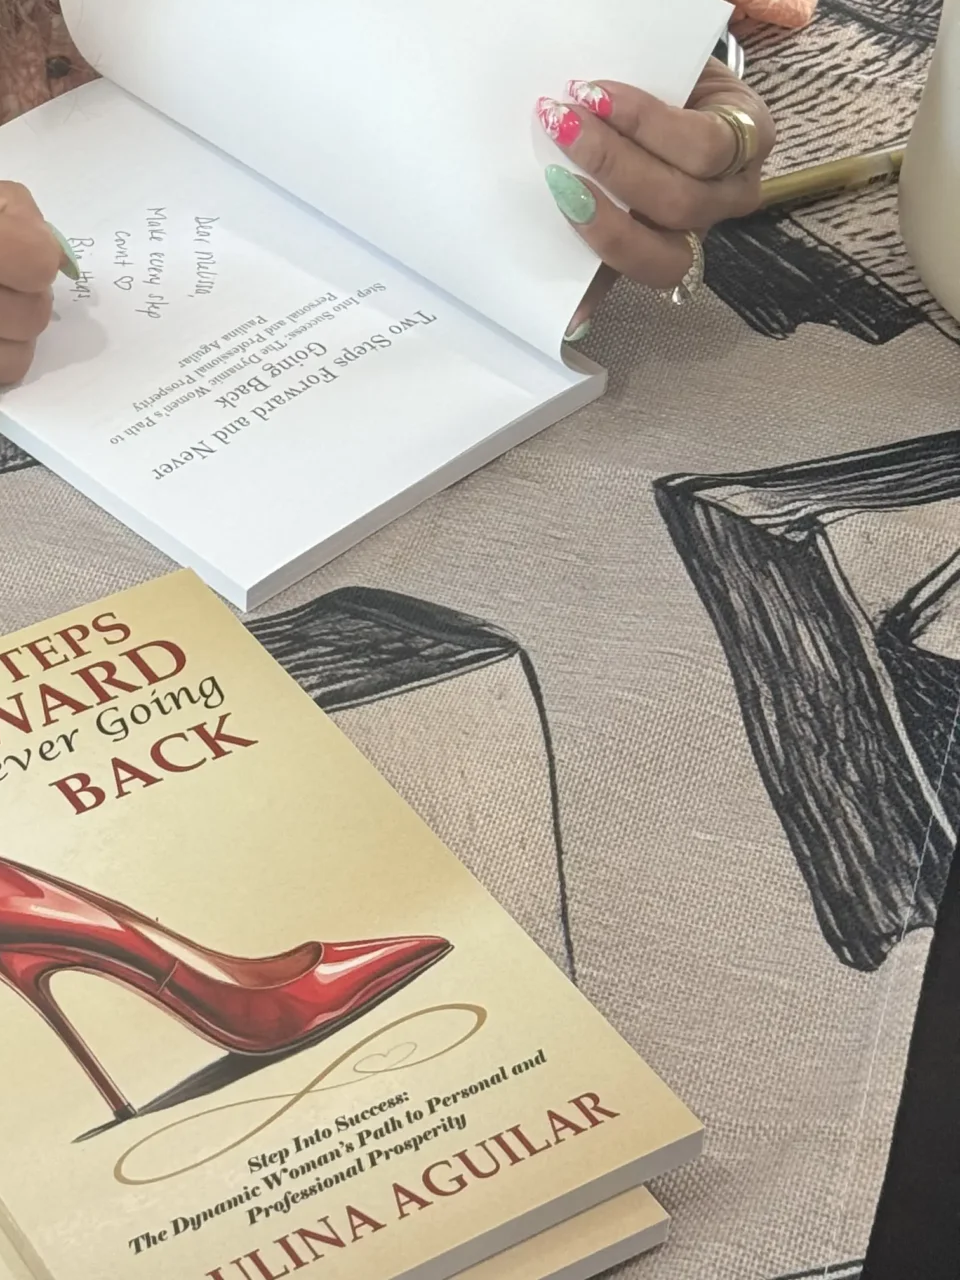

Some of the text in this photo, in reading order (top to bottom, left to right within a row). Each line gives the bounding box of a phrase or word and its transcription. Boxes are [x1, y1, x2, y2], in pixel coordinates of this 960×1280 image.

[135, 207, 169, 319] Make every step
[193, 216, 220, 244] Dear
[332, 296, 360, 313] Into
[357, 282, 387, 299] Step
[132, 291, 338, 413] Personal and Professional Prosperity
[178, 315, 268, 368] Paulina Aguilar
[261, 339, 287, 355] The
[284, 311, 335, 340] Success:
[152, 310, 438, 480] Two Steps Forward and Never
[208, 354, 262, 387] Dynamic
[214, 341, 327, 408] Going Back
[109, 433, 125, 445] to
[123, 416, 157, 437] Path
[95, 675, 225, 741] Going
[49, 712, 259, 815] BACK
[128, 1049, 548, 1256] The Dynamic Woman's Path to Personal and
[247, 1091, 410, 1175] Step Into Success:
[392, 1090, 621, 1220] AGUILAR
[245, 1112, 468, 1226] Professional Prosperity
